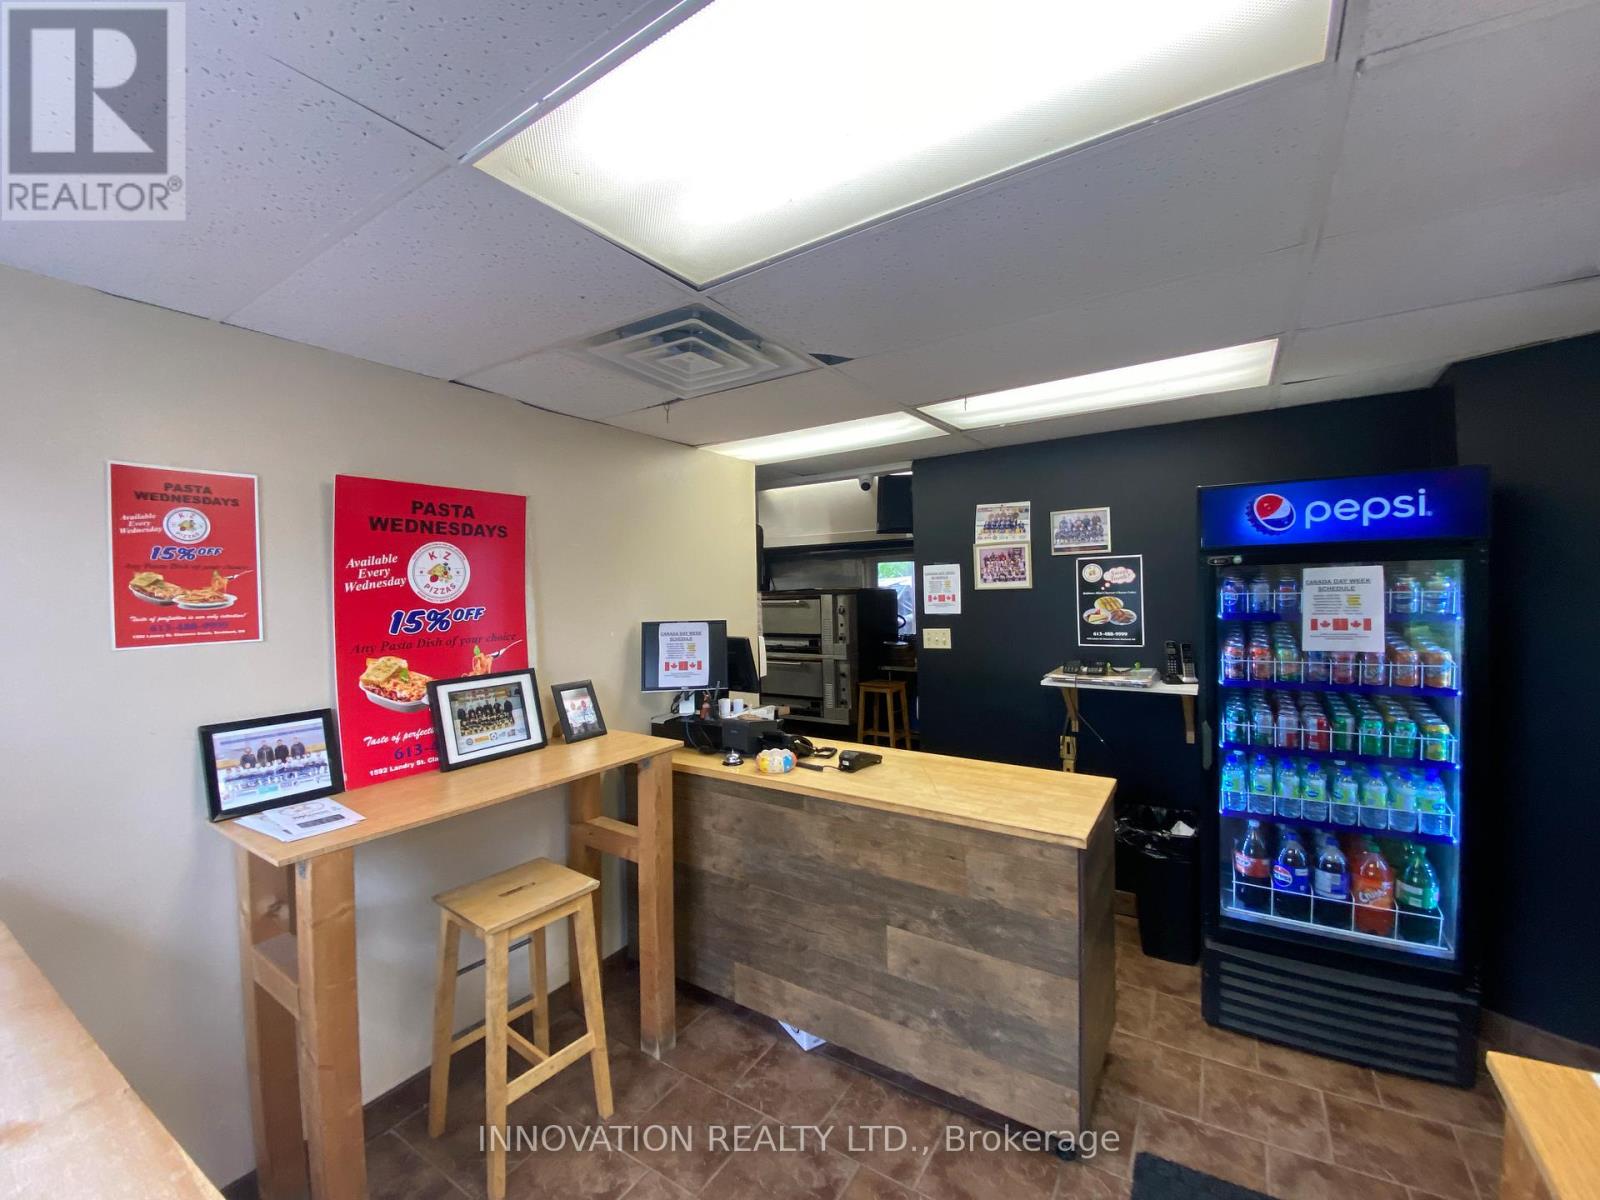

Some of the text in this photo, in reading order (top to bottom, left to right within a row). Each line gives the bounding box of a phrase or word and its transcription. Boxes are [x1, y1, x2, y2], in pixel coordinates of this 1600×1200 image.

[163, 482, 213, 495] PASTA
[133, 490, 240, 507] WEDNESDAYS
[411, 500, 475, 519] PASTA
[369, 516, 508, 538] WEDNESDAYS
[150, 545, 224, 561] 15% OFF
[346, 553, 398, 568] Available
[358, 567, 391, 579] Every
[344, 575, 407, 592] Wednesday
[423, 583, 456, 594] PIZZAS
[389, 607, 485, 635] 15% OFF
[352, 633, 517, 654] Any Pasta Dish of your choice
[363, 727, 435, 747] Taste of perfecti
[389, 762, 415, 772] Landry
